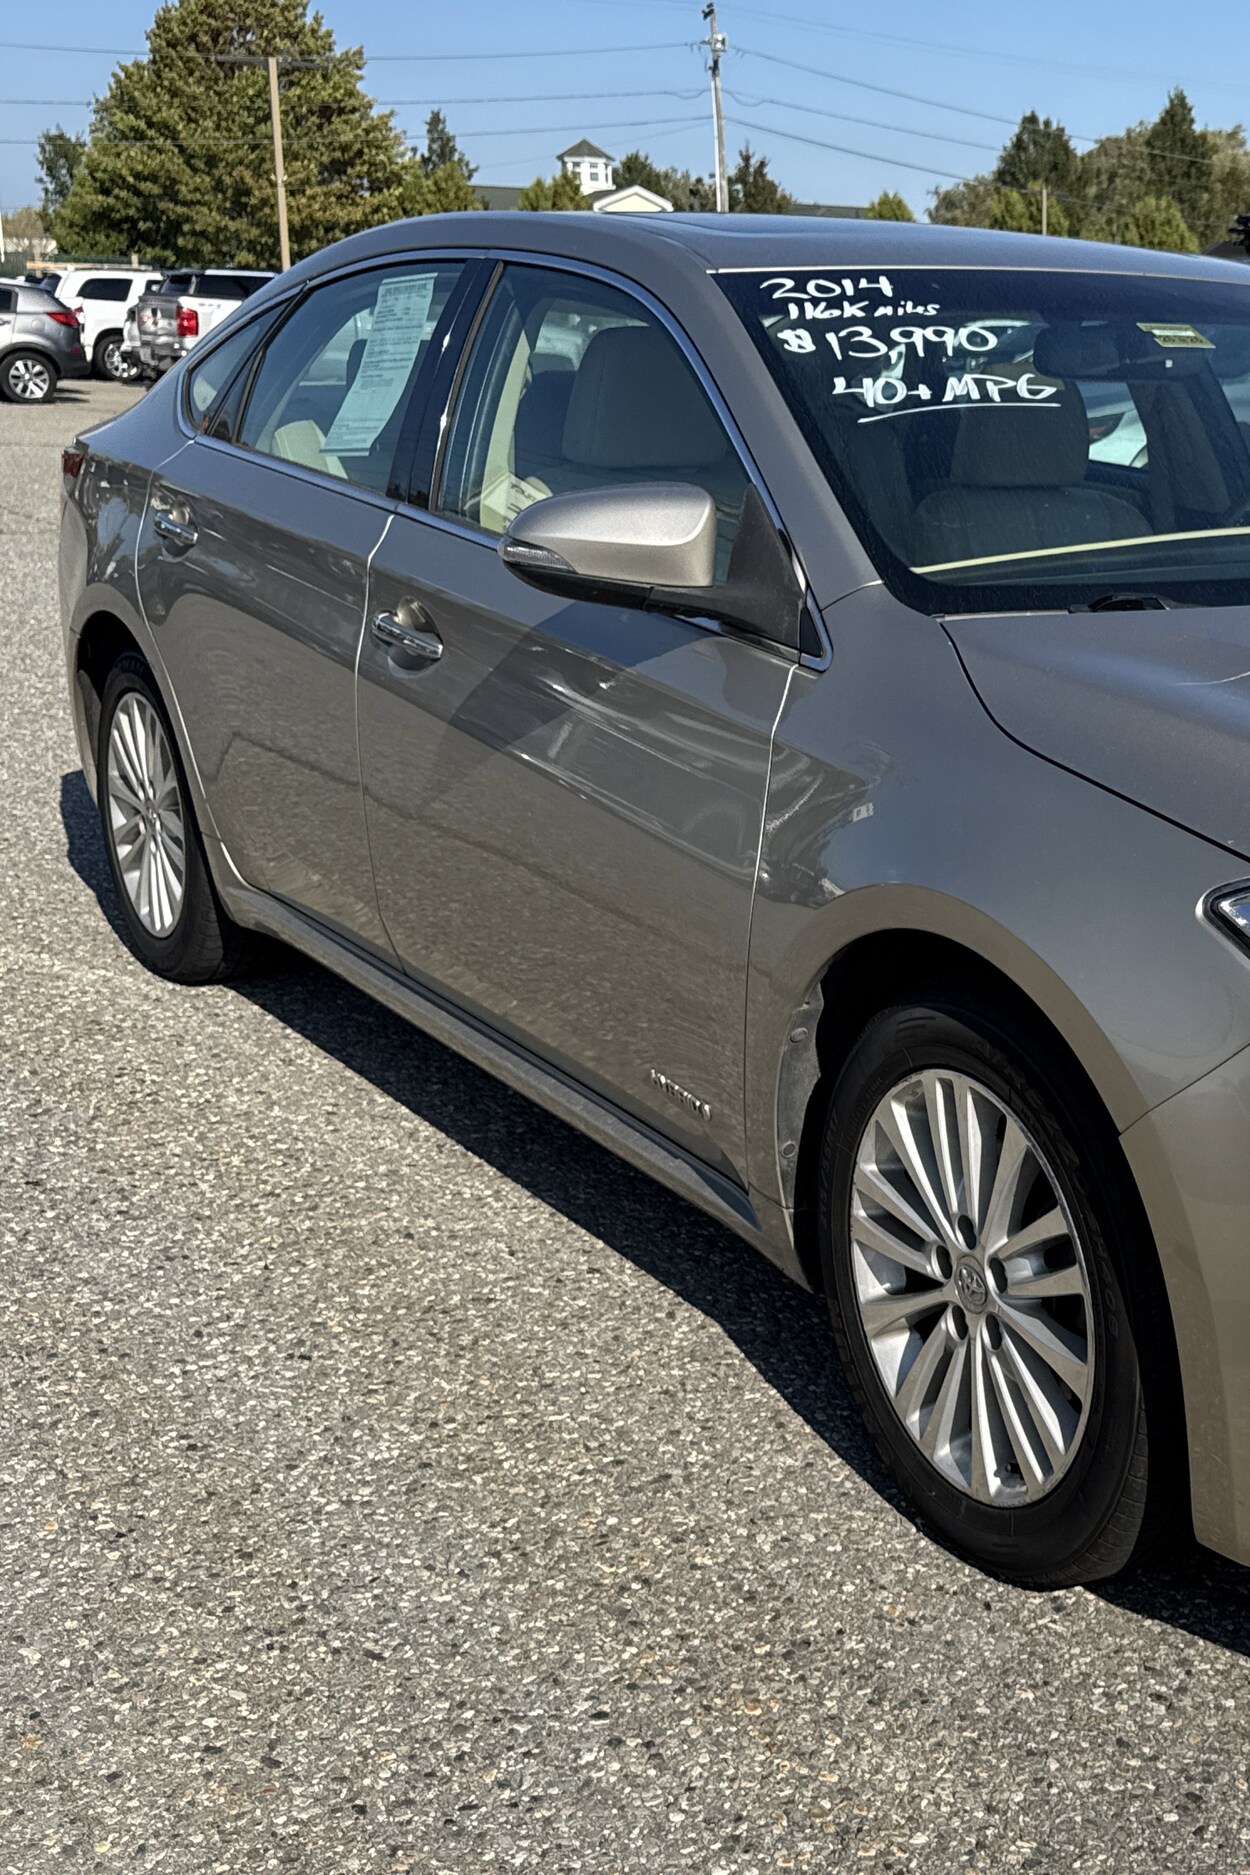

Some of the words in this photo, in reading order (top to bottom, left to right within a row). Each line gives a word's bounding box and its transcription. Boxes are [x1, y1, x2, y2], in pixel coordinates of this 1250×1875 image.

[760, 276, 893, 299] 2014
[788, 301, 869, 320] 116K
[942, 373, 1057, 402] MPG
